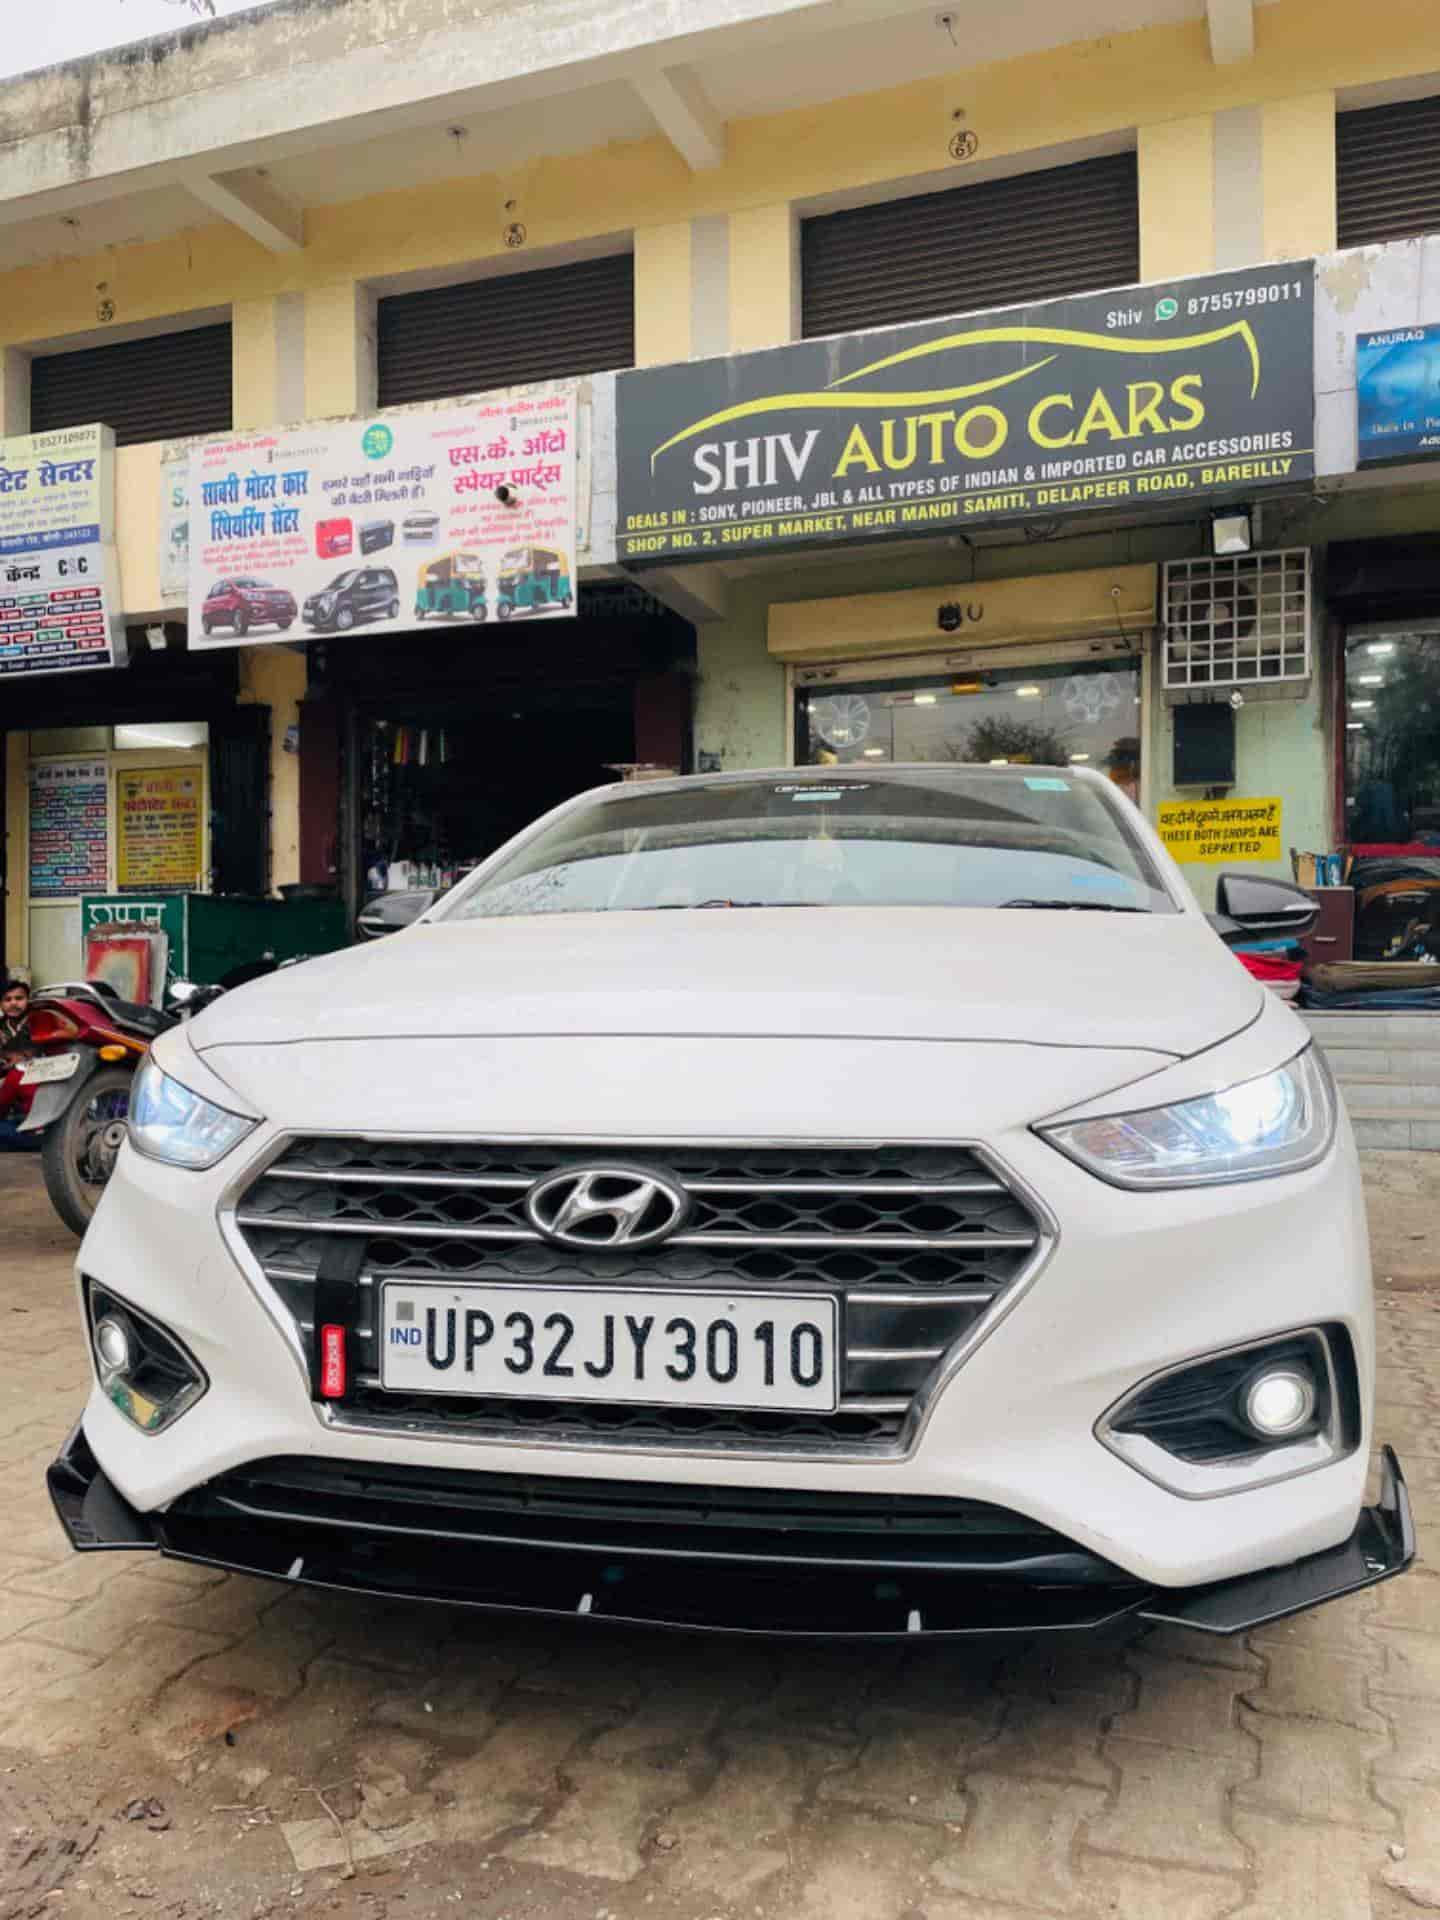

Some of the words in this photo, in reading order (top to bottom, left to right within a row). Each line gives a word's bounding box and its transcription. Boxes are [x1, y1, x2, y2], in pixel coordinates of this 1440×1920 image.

[1106, 309, 1142, 329] Shiv
[1187, 282, 1302, 315] 8755799011
[1368, 330, 1425, 347] ANURAG
[693, 430, 821, 495] SHIV
[832, 405, 1008, 478] AUTO
[1028, 374, 1205, 448] CARS
[627, 511, 669, 530] DEALS
[671, 509, 687, 525] IN
[811, 492, 839, 509] JBL
[843, 490, 854, 504] &
[858, 485, 884, 501] ALL
[888, 478, 935, 499] TYPES
[940, 473, 960, 491] OF
[964, 467, 1019, 489] INDIAN
[1023, 465, 1036, 480] &
[1041, 453, 1127, 481] IMPORTED
[1132, 446, 1166, 467] CAR
[1171, 431, 1293, 462] ACCESSORIES
[627, 536, 667, 554] SHOP
[671, 533, 697, 549] NO.
[721, 525, 773, 544] SUPER
[852, 510, 896, 529] NEAR
[902, 501, 958, 523] MANDI
[963, 492, 1031, 515] SAMITI,
[1037, 480, 1130, 505] DELAPEER
[1136, 472, 1195, 494] ROAD,
[1202, 458, 1293, 485] BAREILLY
[390, 1326, 422, 1347] IND
[425, 1307, 824, 1387] UP32JY3010
